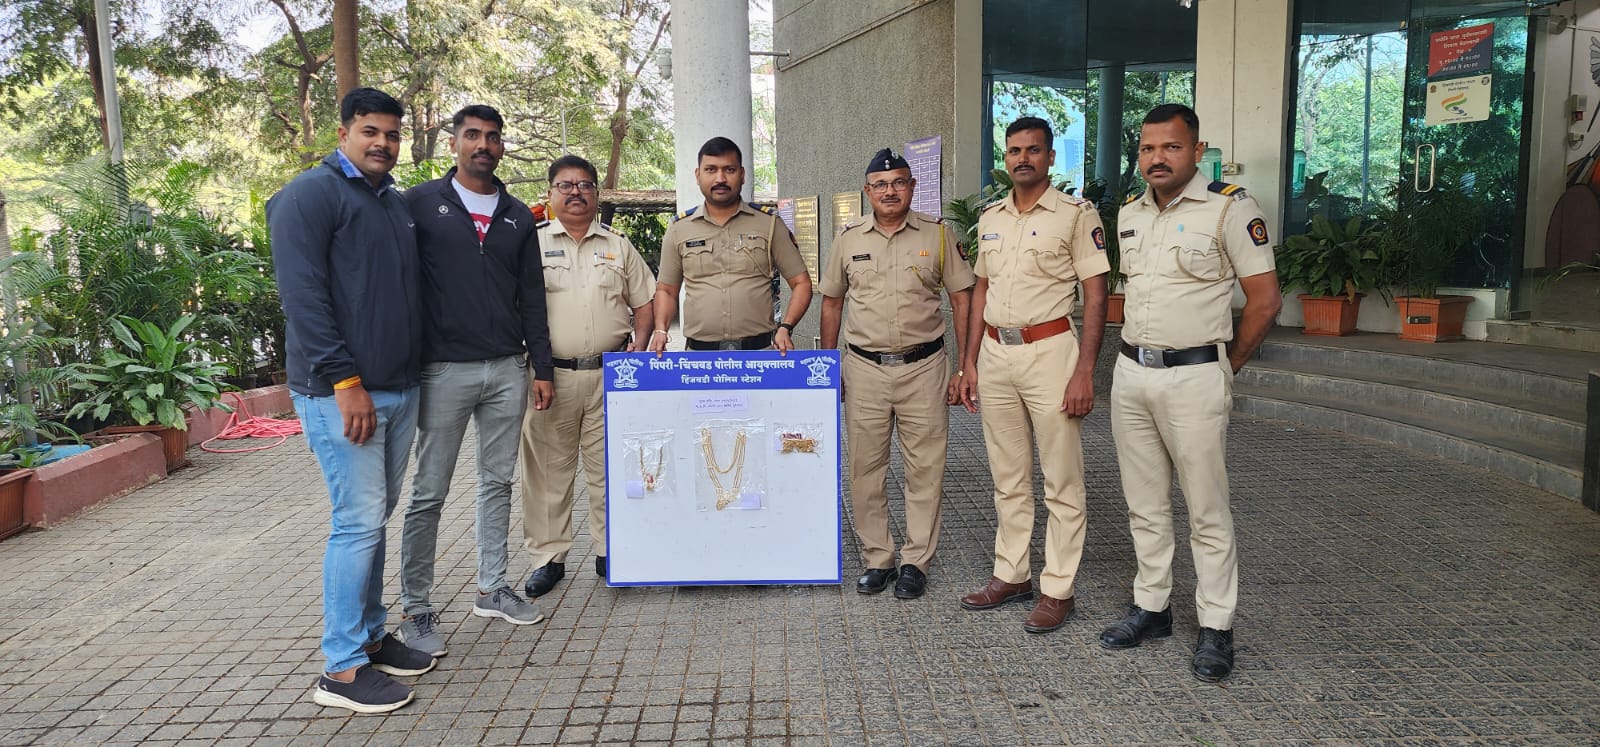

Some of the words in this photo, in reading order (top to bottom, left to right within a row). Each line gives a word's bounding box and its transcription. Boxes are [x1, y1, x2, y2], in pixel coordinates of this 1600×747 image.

[649, 357, 712, 370] पिंपरी-चिंचवड
[714, 357, 743, 370] पोलीस
[745, 359, 795, 373] आयुक्तालय
[681, 374, 710, 384] हिंजवडी
[740, 374, 762, 383] स्टेशन
